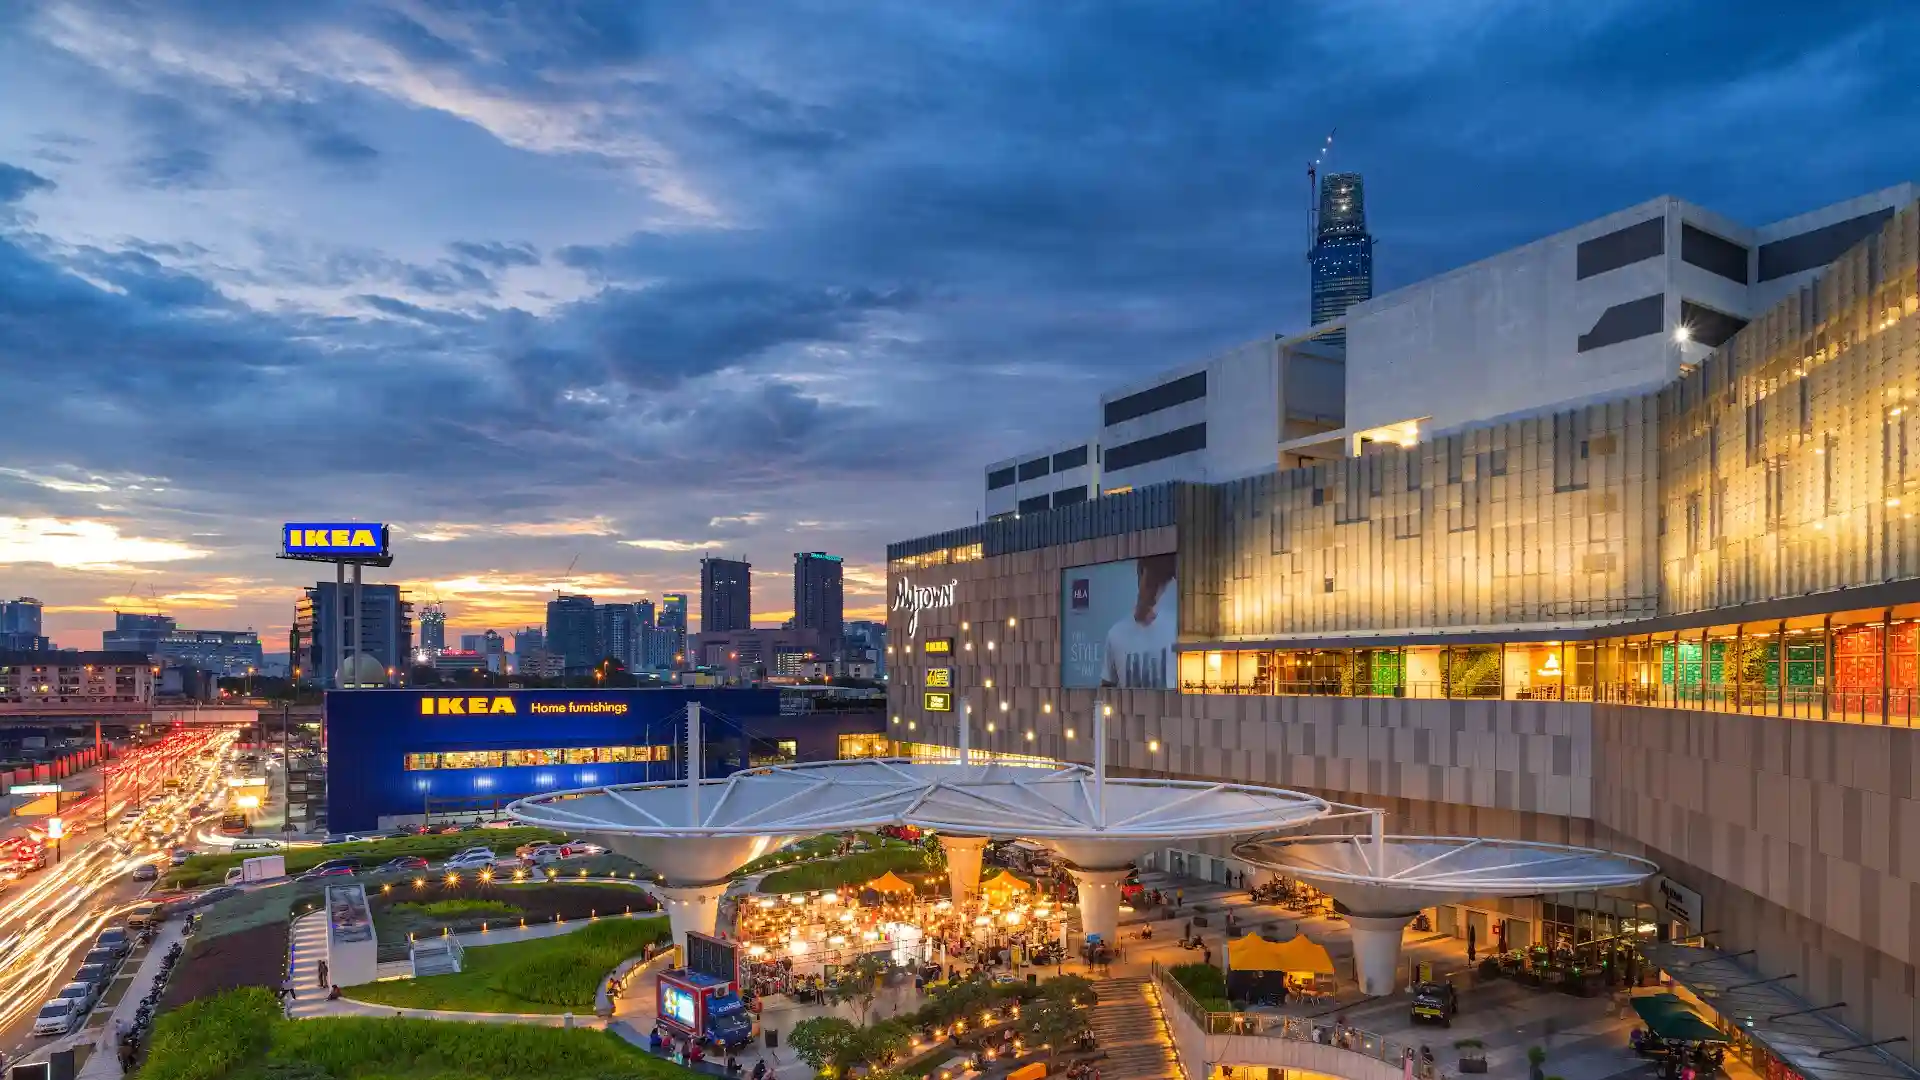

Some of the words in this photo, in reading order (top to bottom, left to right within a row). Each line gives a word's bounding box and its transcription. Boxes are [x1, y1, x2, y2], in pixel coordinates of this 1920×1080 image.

[290, 529, 376, 547] IKEA
[1071, 642, 1099, 661] STYLE
[421, 697, 516, 714] IKEA
[531, 702, 566, 713] Home
[569, 701, 628, 714] furnishings
